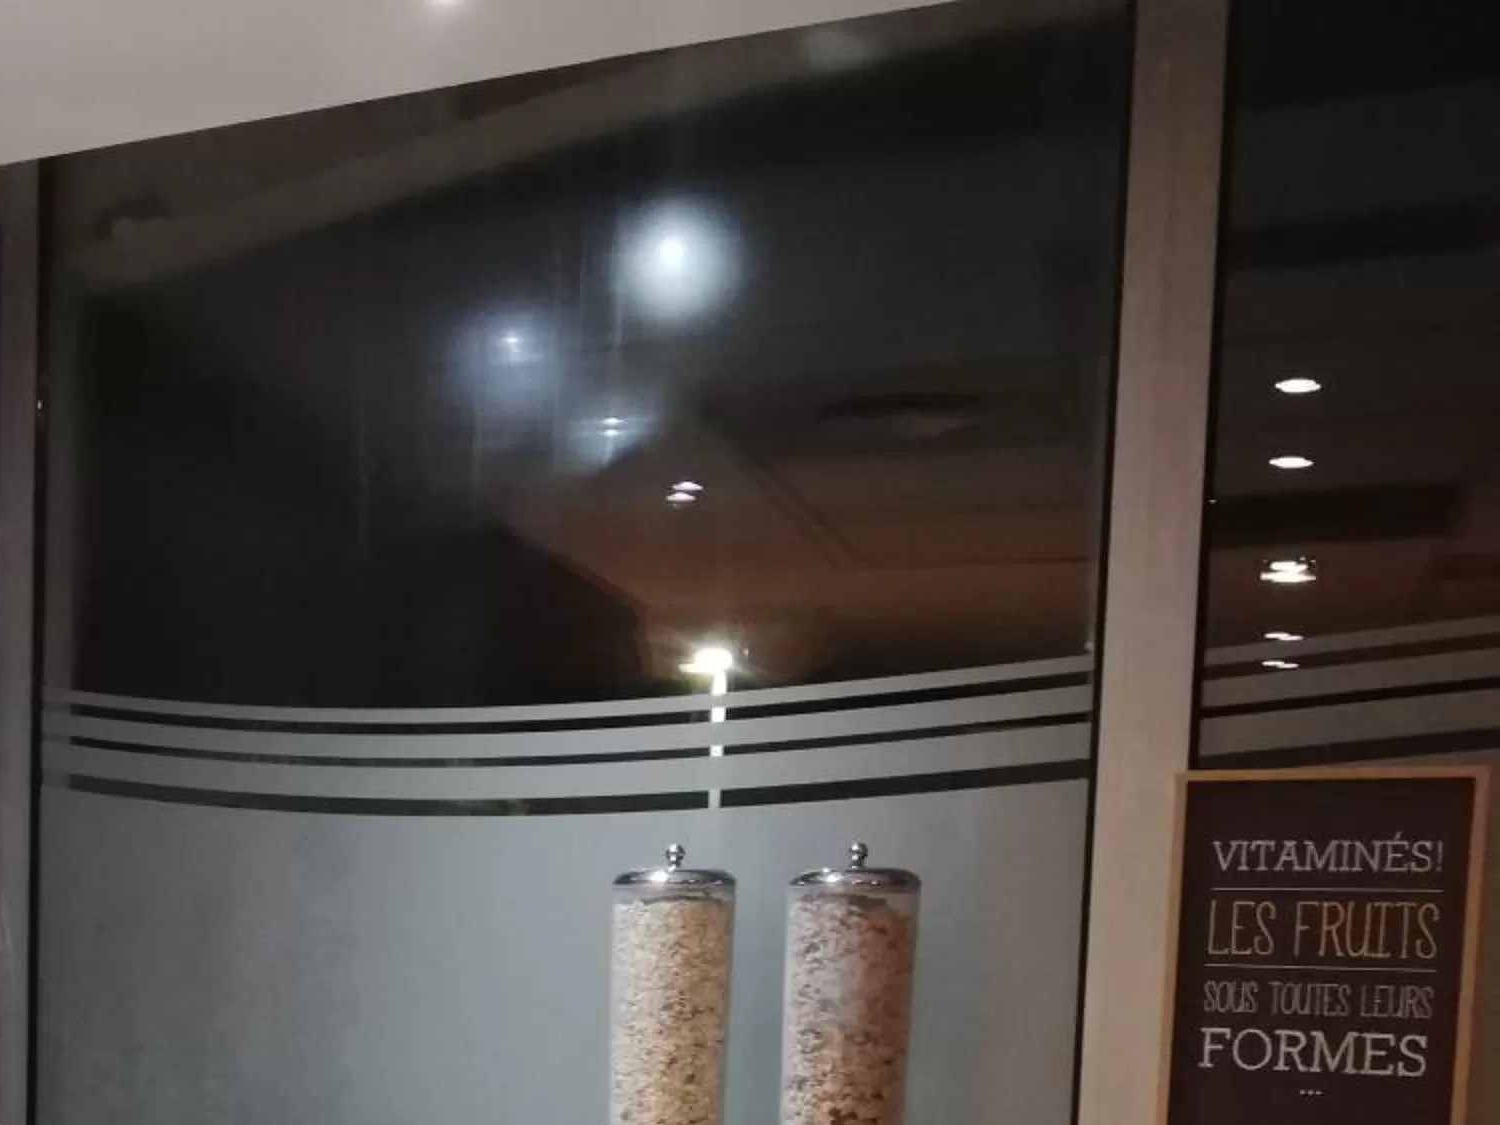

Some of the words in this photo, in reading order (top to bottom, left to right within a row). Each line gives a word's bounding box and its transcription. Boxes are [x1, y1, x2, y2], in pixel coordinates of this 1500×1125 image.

[1213, 832, 1444, 873] VITAMINÉS!
[1206, 900, 1276, 956] LES
[1294, 901, 1440, 960] FRUITS
[1203, 980, 1259, 1013] SOUS
[1268, 981, 1351, 1017] TOUTES
[1360, 984, 1434, 1019] LEURS
[1198, 1027, 1428, 1077] FORMES
